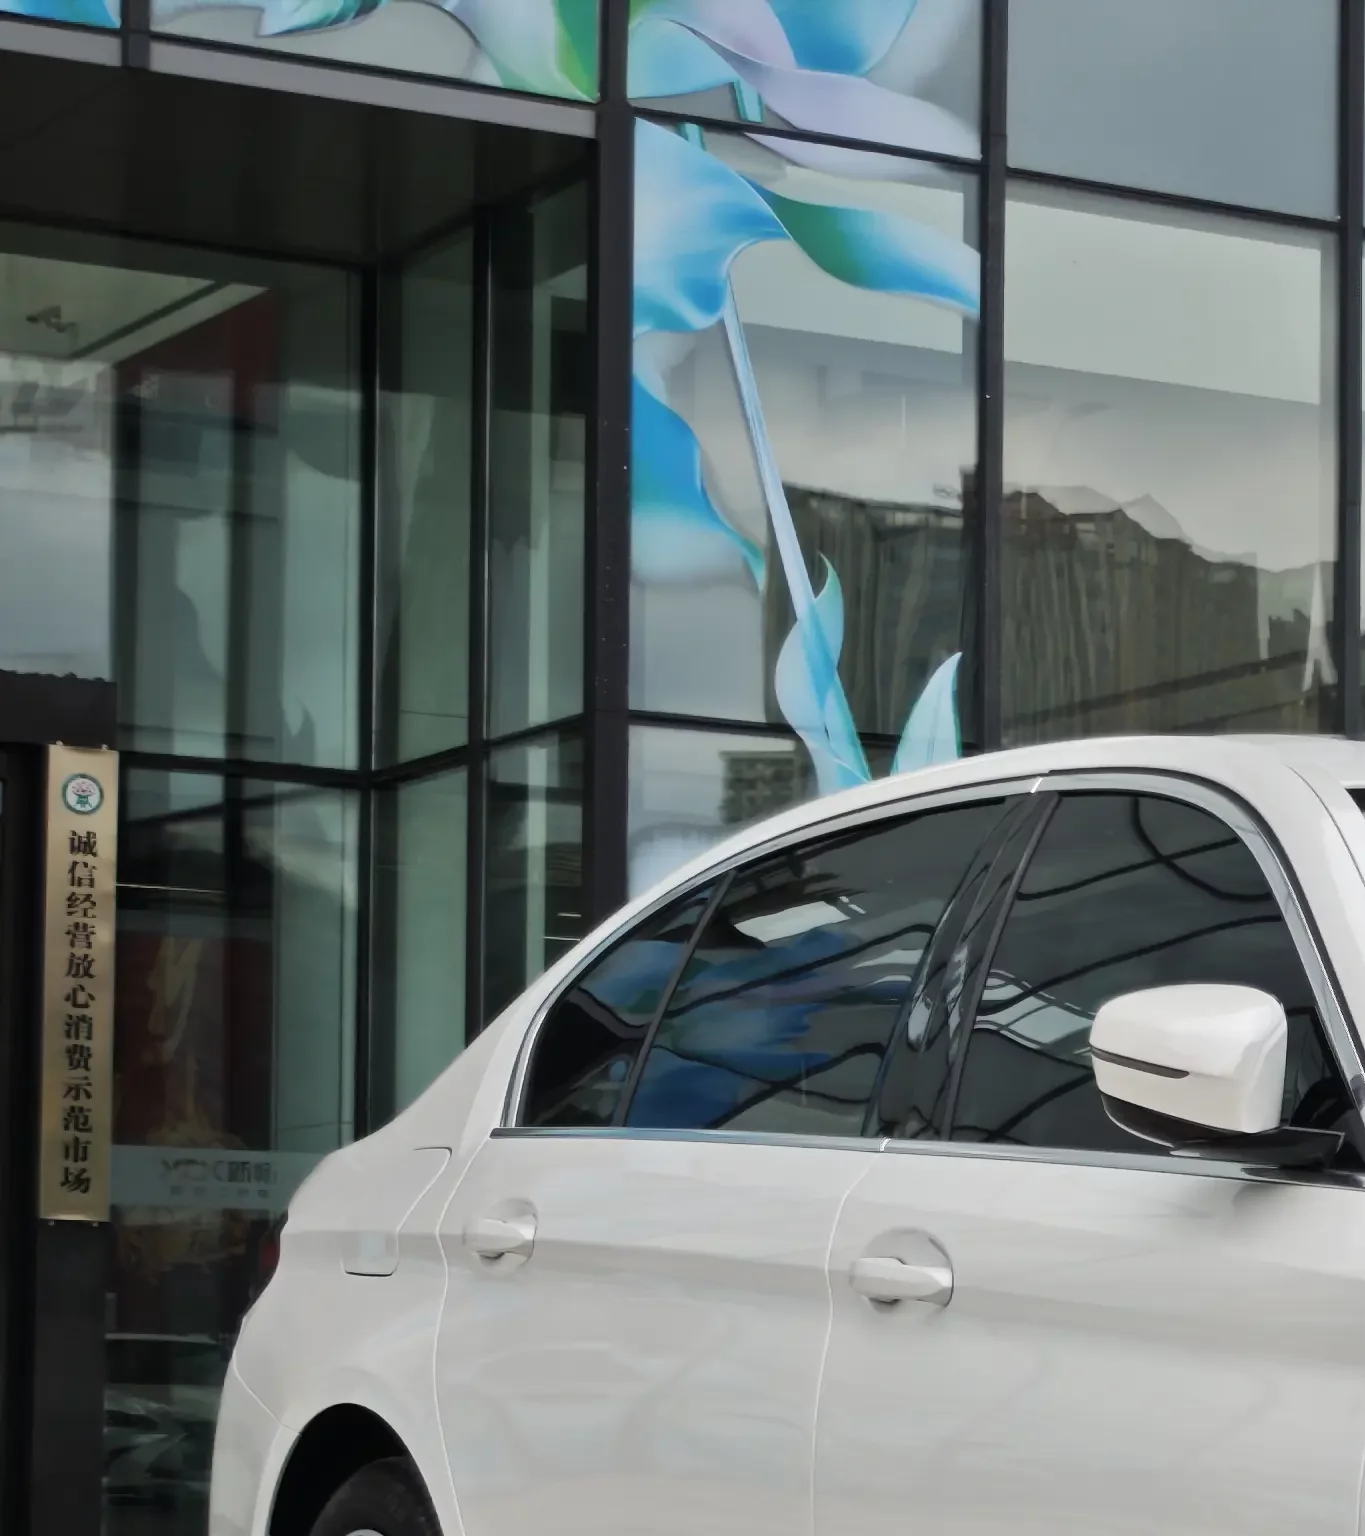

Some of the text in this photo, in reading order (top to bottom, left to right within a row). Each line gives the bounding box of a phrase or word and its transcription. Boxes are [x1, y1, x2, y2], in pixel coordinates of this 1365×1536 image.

[59, 829, 99, 1196] 诚信经营放心消费示范市场
